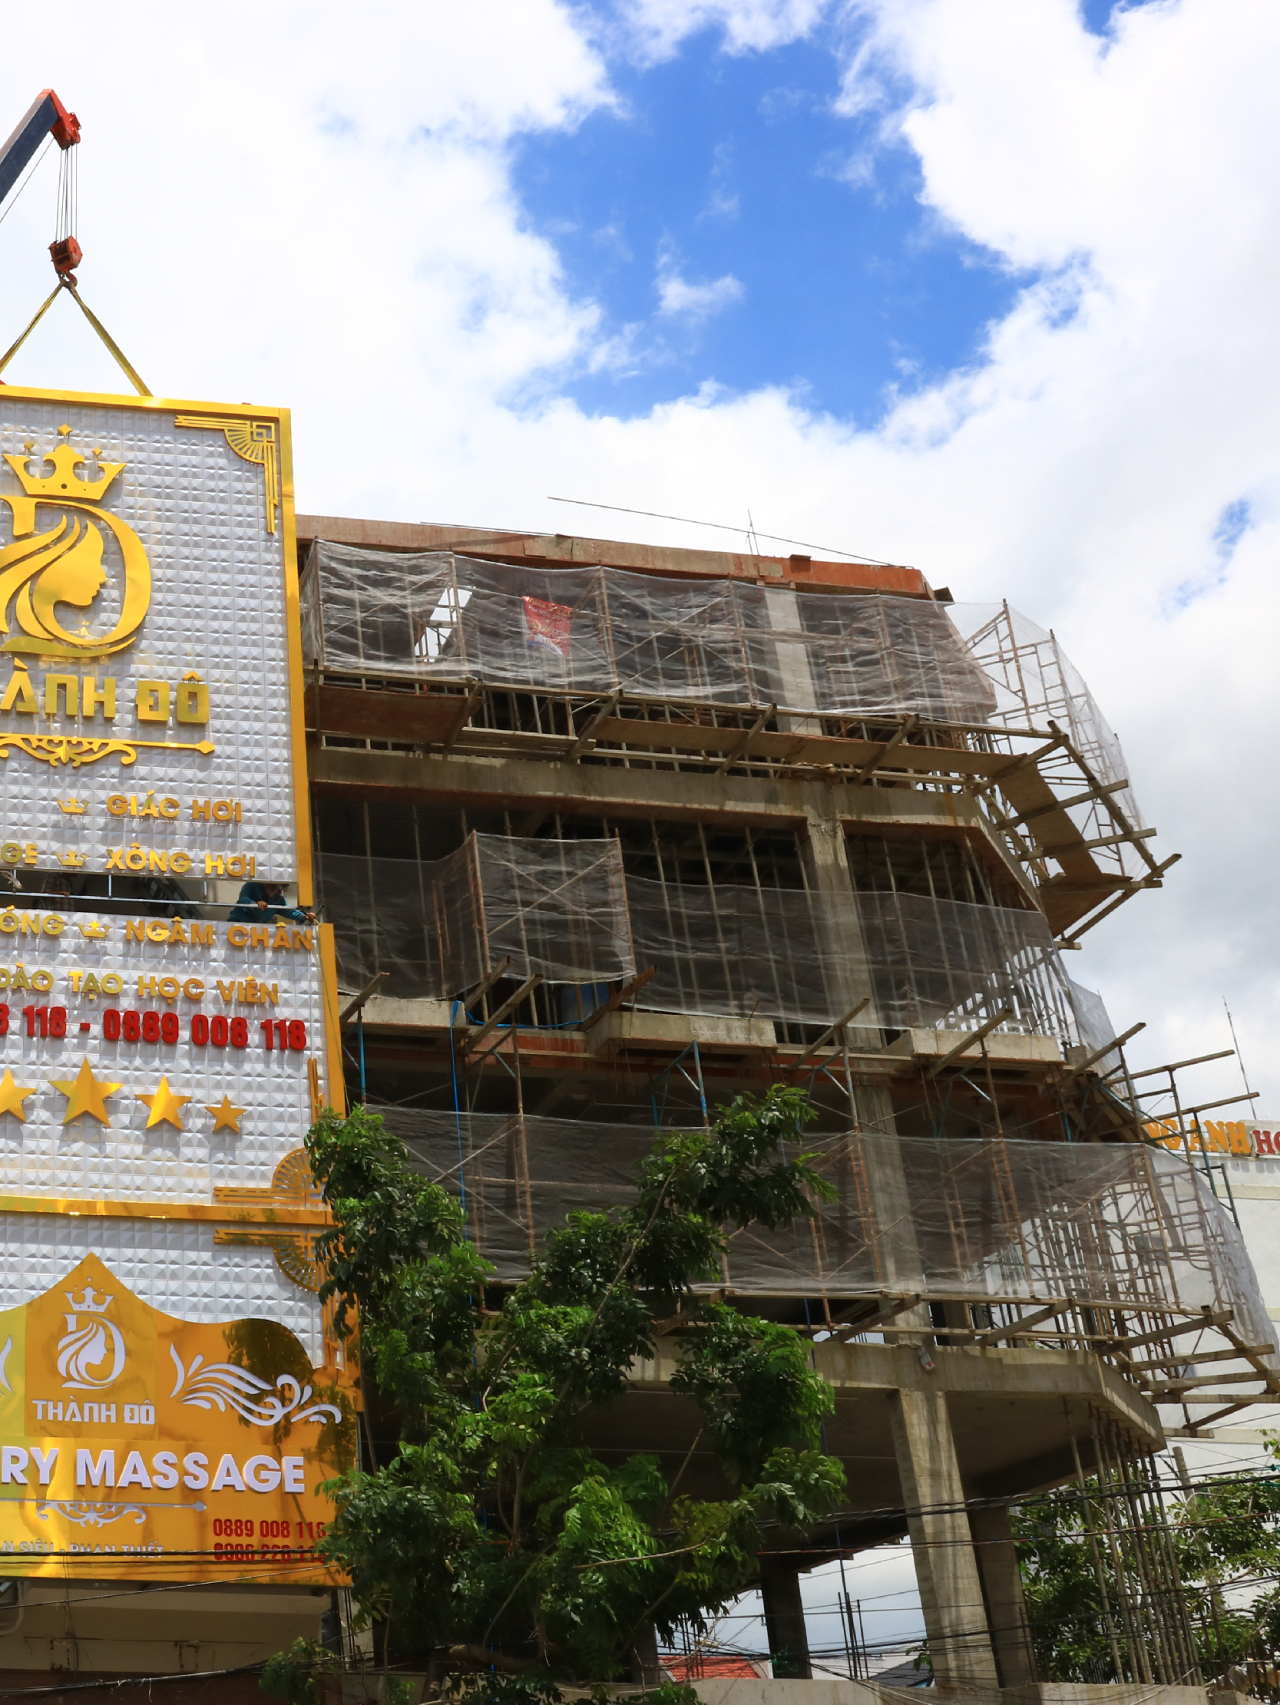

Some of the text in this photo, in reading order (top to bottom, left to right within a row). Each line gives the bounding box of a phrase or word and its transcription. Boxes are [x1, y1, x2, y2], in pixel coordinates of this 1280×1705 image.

[136, 670, 210, 724] ĐÔ
[106, 790, 242, 823] GIÁC HƠI
[105, 842, 256, 878] XÔNG HƠI
[126, 916, 313, 951] NGÂM CHÂN
[68, 970, 124, 1000] TẠO
[137, 975, 205, 1005] HỌC
[216, 975, 279, 1004] VIÊN
[22, 1004, 67, 1038] 118
[103, 1009, 180, 1044] 0889
[191, 1014, 249, 1048] 008
[260, 1018, 307, 1051] 118
[1190, 1119, 1252, 1154] ANH
[31, 1394, 156, 1425] THÀNH ĐÔ
[75, 1447, 306, 1494] MASSAGE
[213, 1518, 255, 1538] 0889
[260, 1520, 291, 1539] 008
[20, 1538, 54, 1553] SIÊU
[69, 1543, 116, 1556] PHAN
[121, 1541, 164, 1558] THIẾT
